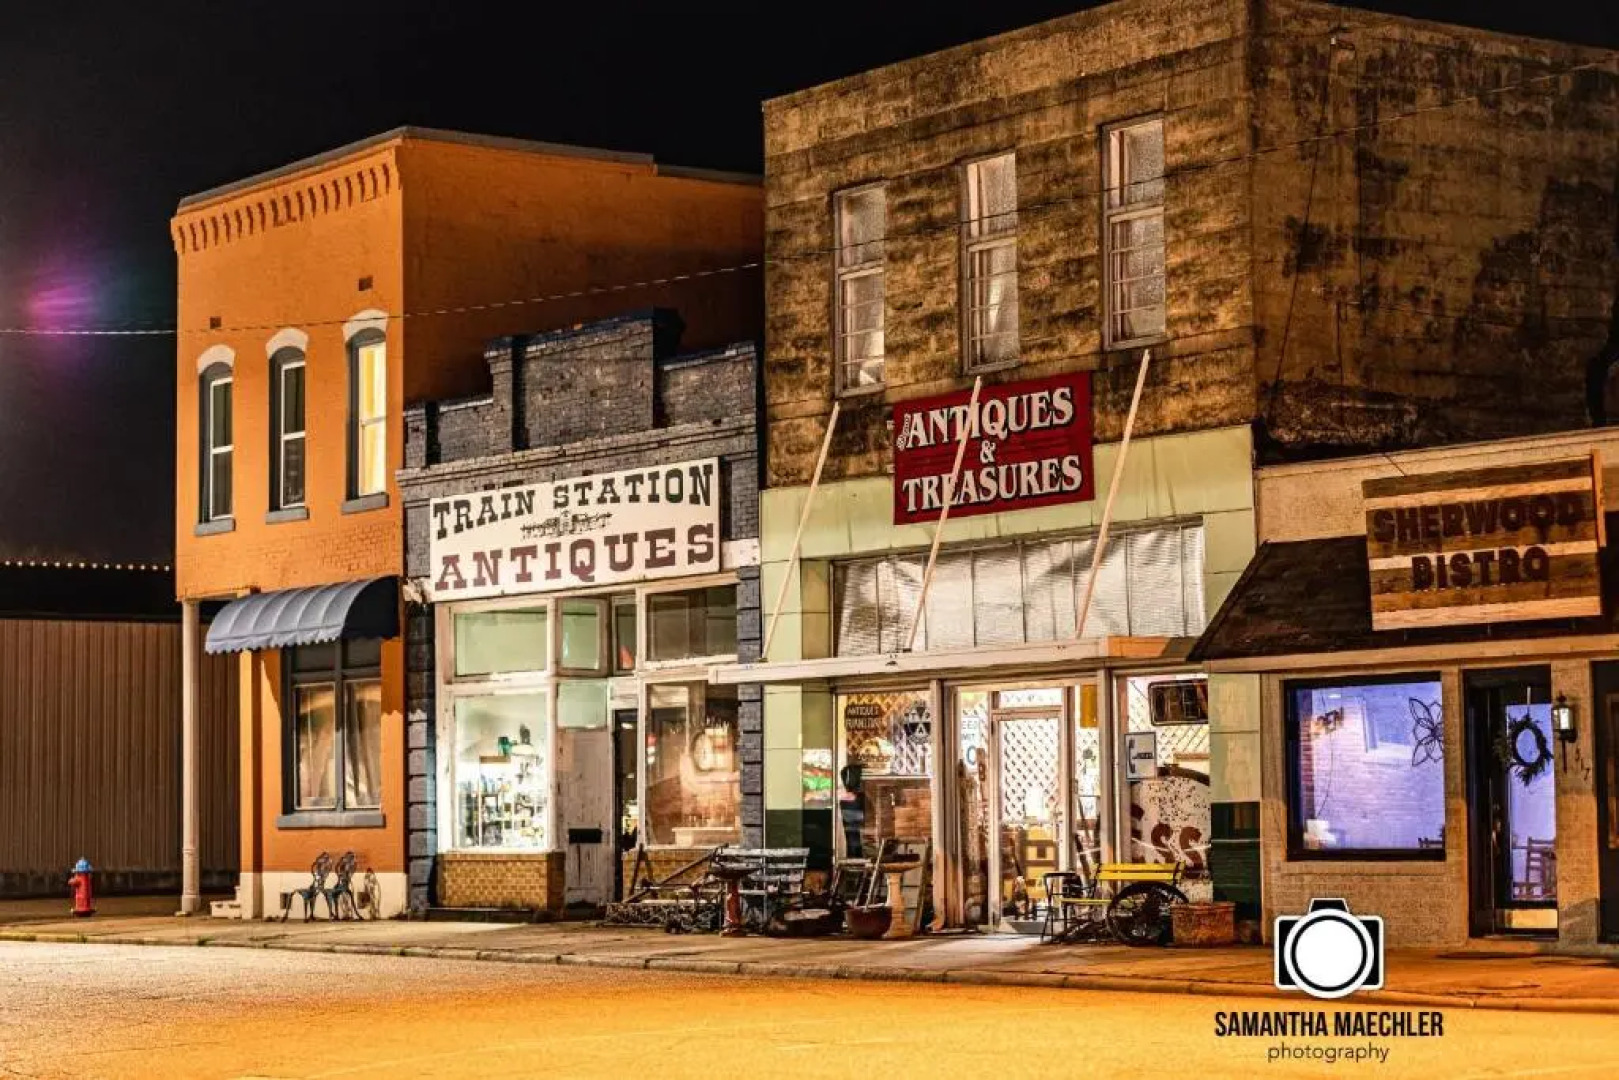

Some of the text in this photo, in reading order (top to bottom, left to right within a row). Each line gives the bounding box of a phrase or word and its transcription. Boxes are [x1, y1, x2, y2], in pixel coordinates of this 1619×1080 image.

[906, 386, 1074, 449] ANTIQUES
[979, 440, 996, 464] &
[433, 464, 714, 540] TRAIN STATION
[902, 455, 1083, 512] TREASURES
[1373, 495, 1585, 544] SHERWOOD
[434, 523, 715, 591] ANTIQUES
[1412, 546, 1549, 591] BISTRO
